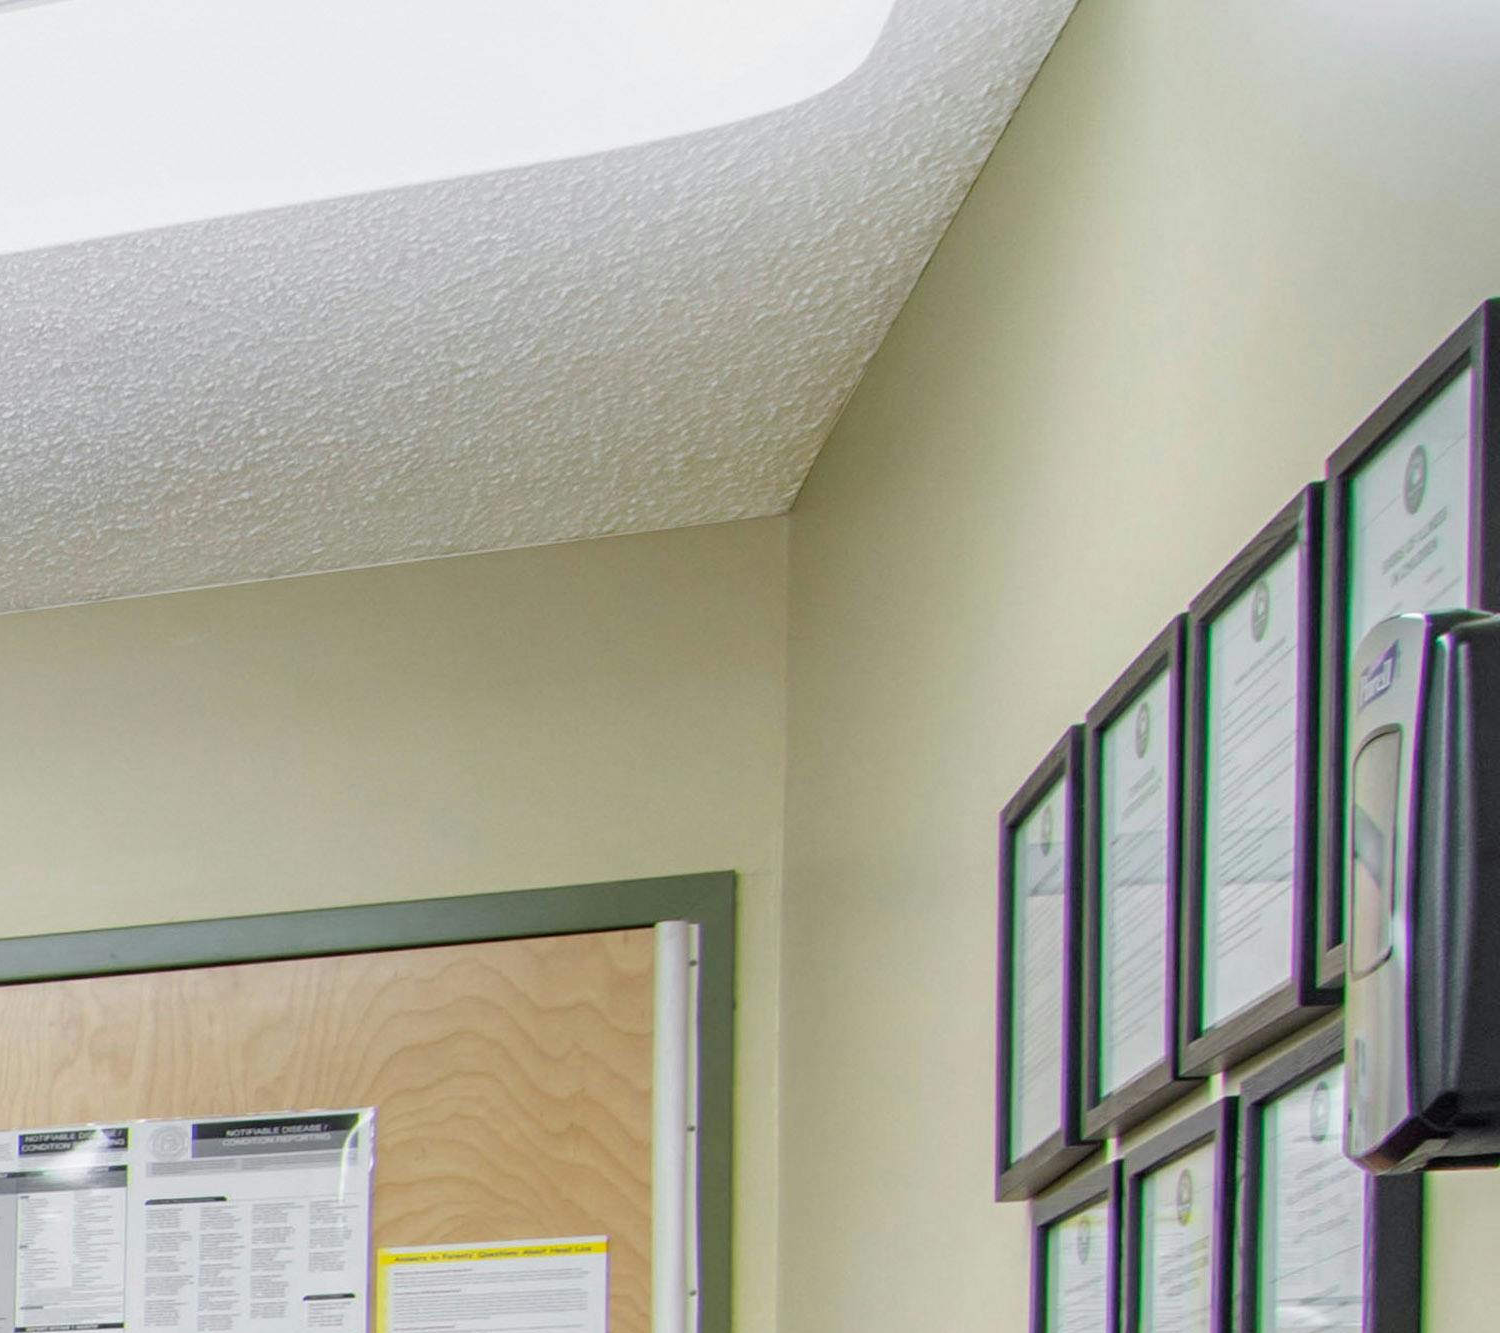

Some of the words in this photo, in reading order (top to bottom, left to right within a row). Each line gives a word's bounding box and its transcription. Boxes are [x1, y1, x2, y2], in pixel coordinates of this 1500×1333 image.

[226, 1126, 280, 1137] NOTIFIABLE
[282, 1123, 322, 1134] DISEASE
[24, 1132, 76, 1142] NOTIFIABLE
[21, 1142, 72, 1152] CONDITION
